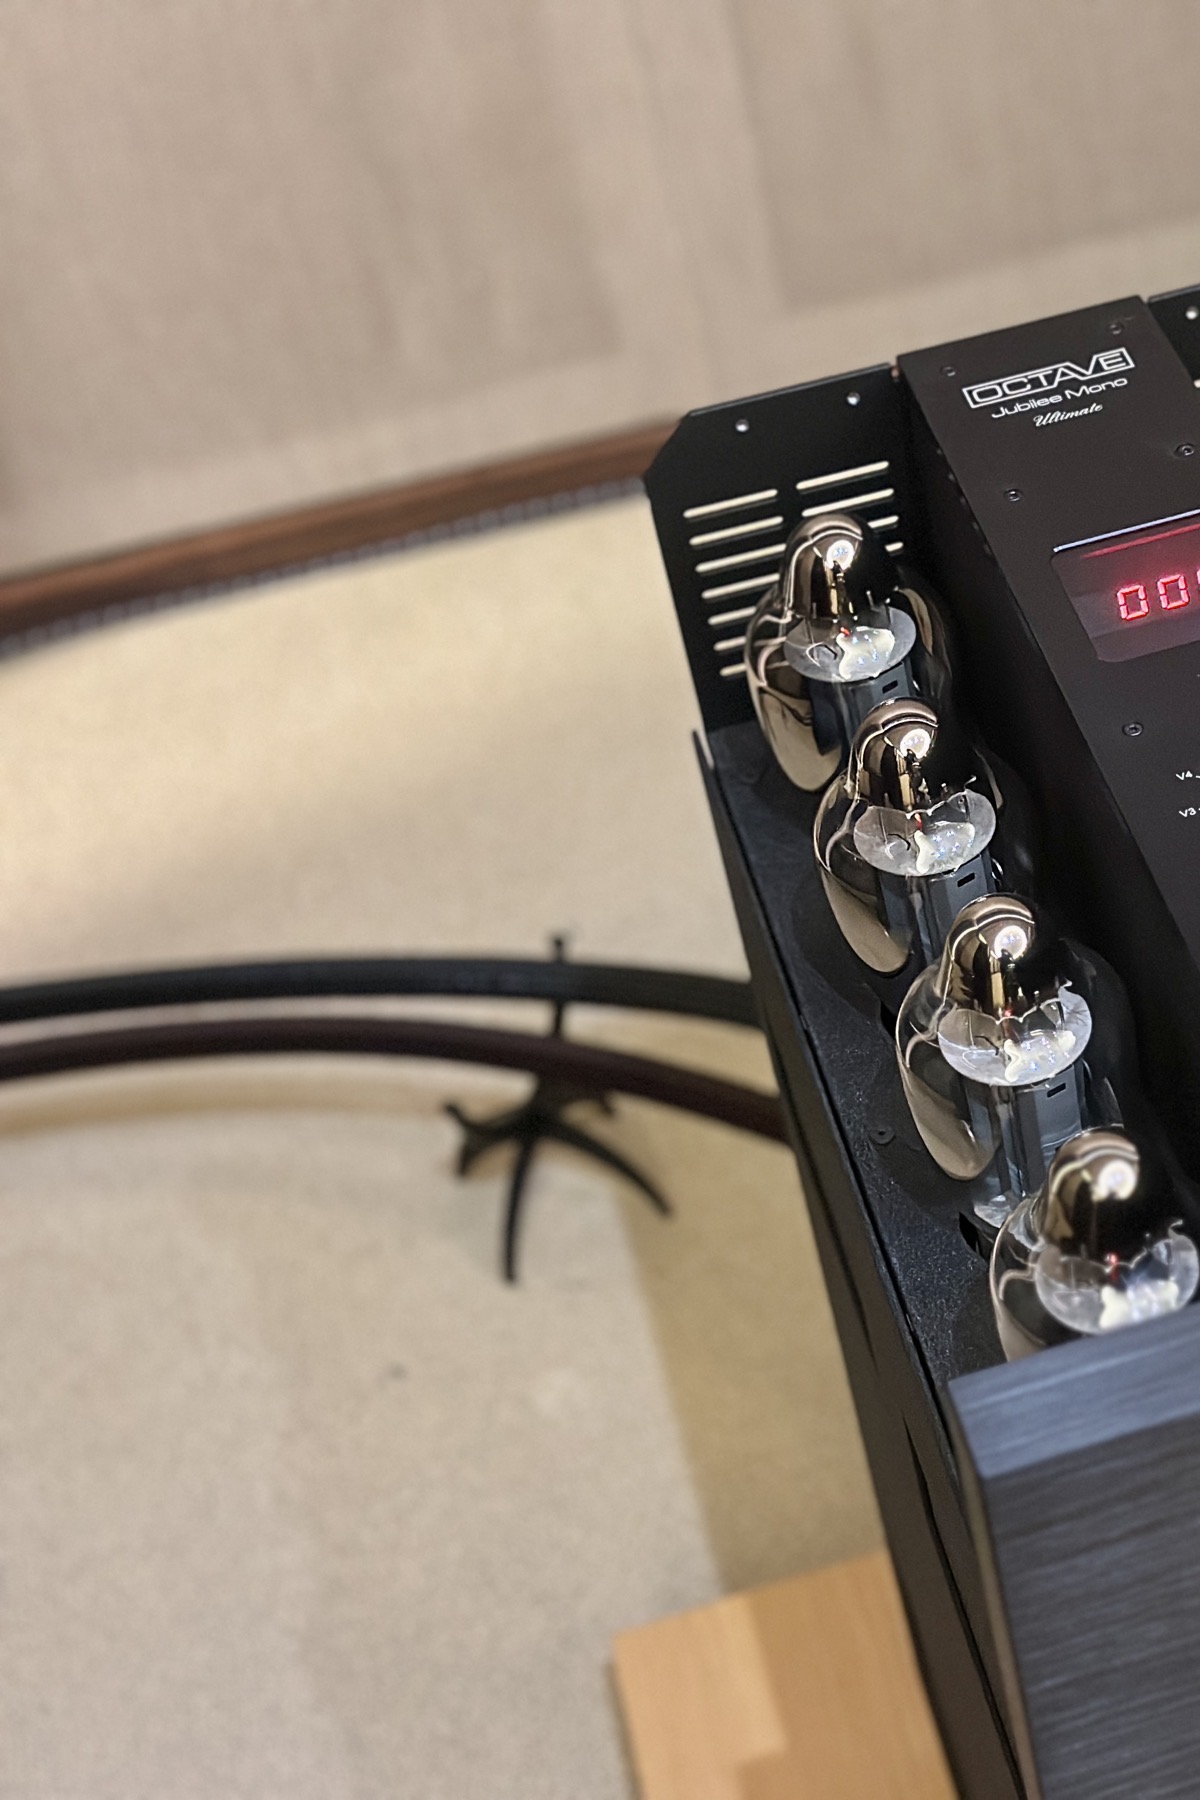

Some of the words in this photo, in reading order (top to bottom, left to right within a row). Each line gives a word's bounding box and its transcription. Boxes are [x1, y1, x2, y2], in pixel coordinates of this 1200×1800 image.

[962, 347, 1135, 408] OCTAVE
[991, 394, 1063, 418] Jubilee
[1064, 377, 1128, 399] Mono
[1033, 402, 1104, 427] Ultimate
[1175, 770, 1193, 781] V4
[1179, 807, 1197, 818] V3
